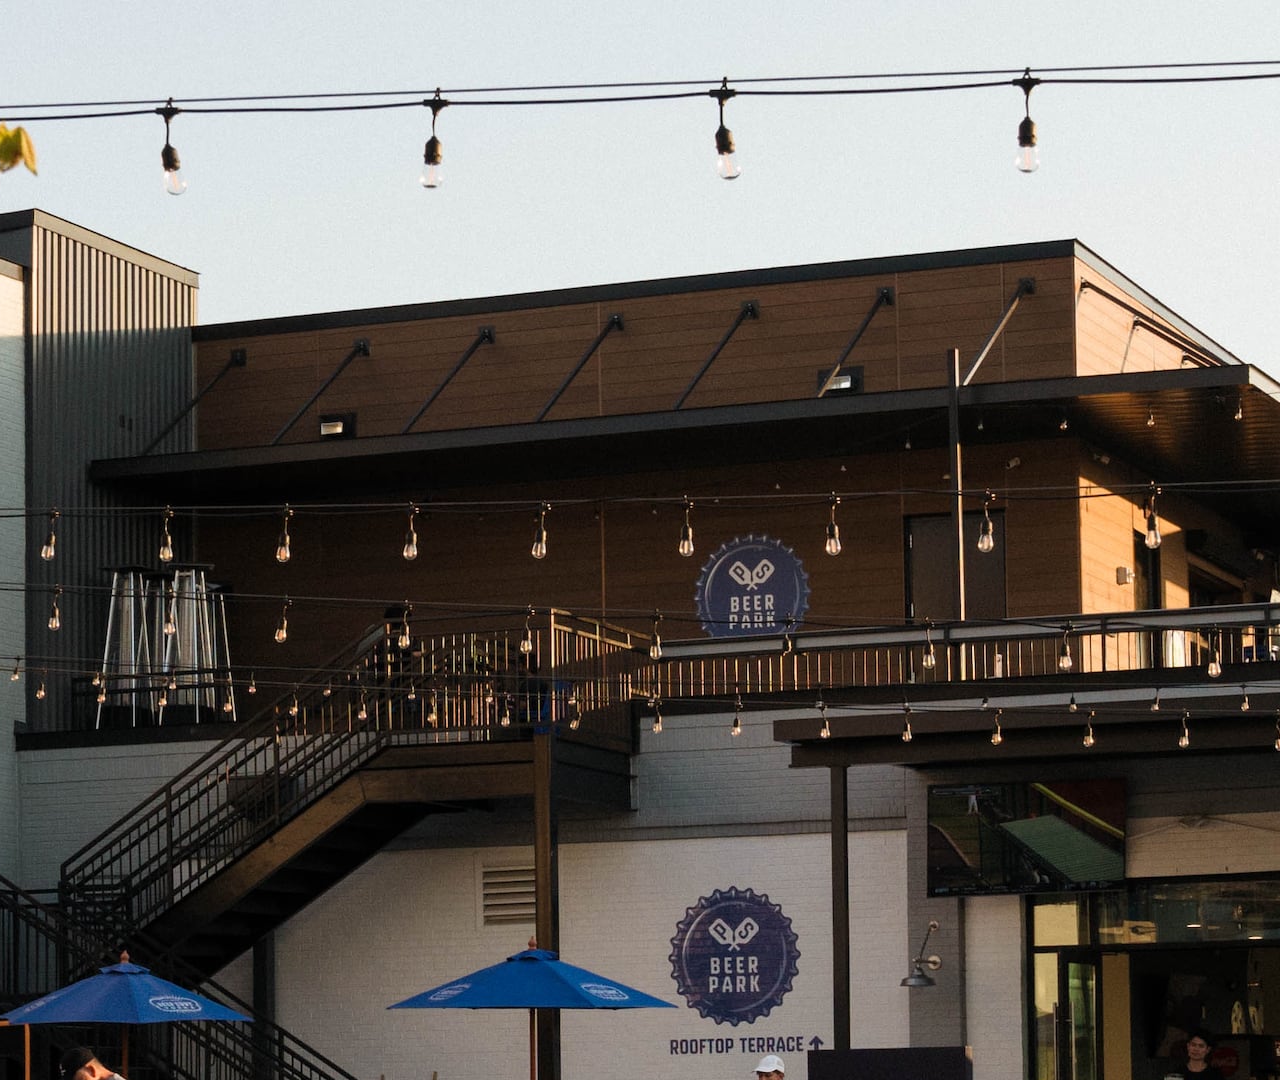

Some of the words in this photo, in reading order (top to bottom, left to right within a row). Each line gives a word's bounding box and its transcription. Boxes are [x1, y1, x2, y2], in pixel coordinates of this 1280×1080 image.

[730, 594, 775, 612] BEER
[728, 612, 776, 629] PARK
[710, 956, 759, 975] BEER
[708, 975, 760, 993] PARK
[670, 1038, 734, 1055] ROOFTOP
[740, 1036, 804, 1053] TERRACE
